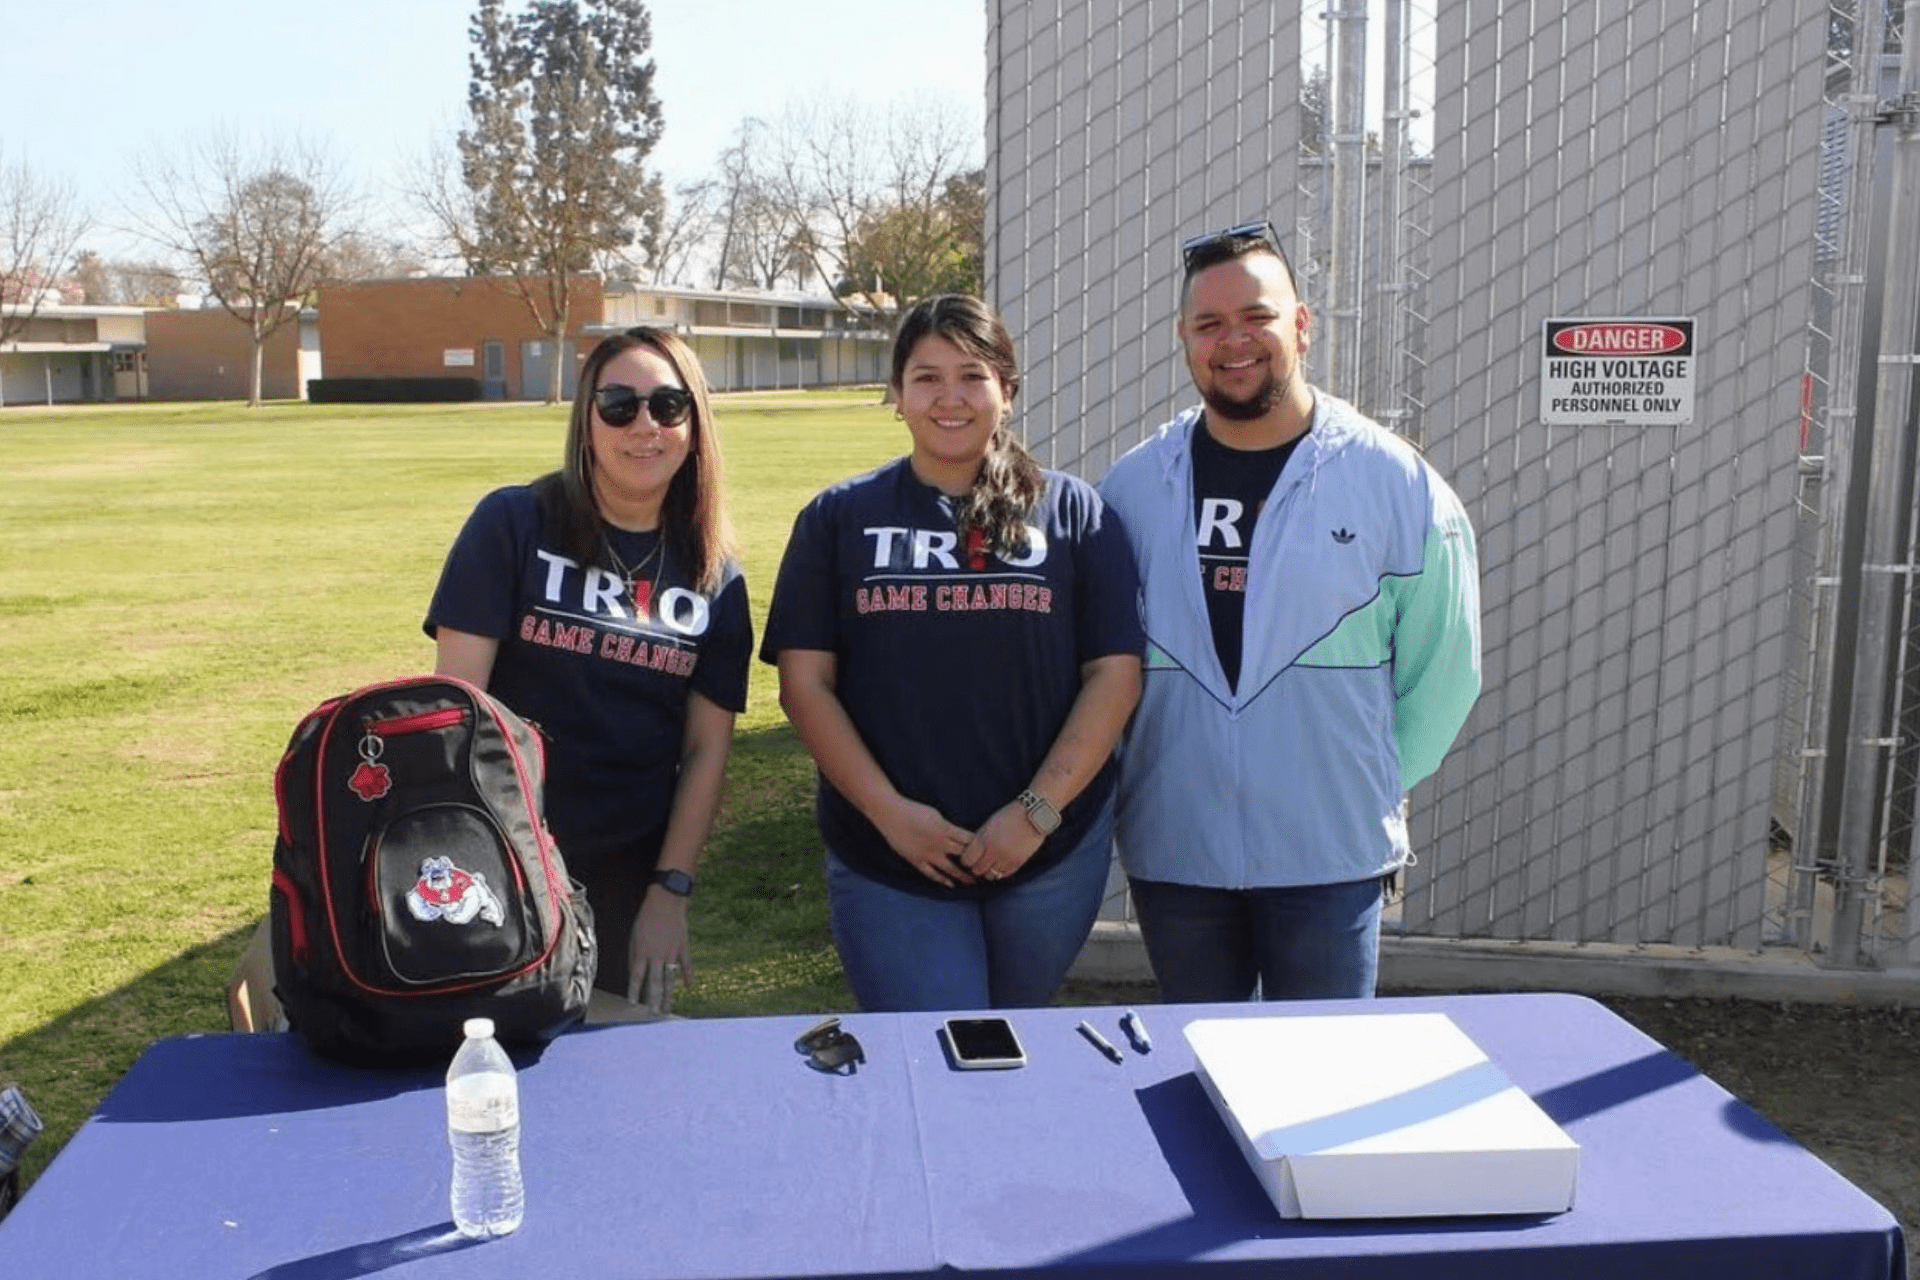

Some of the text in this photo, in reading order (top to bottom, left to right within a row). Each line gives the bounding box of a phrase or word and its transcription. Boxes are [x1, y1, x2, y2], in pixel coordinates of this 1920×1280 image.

[1573, 329, 1665, 350] DANGER
[1550, 360, 1687, 379] HIGH VOLTAGE
[1571, 381, 1664, 396] AUTHORIZED
[1552, 398, 1681, 413] PERSONNEL ONLY
[856, 583, 1052, 614] GAME CHANGER
[520, 614, 697, 677] GAME CHANGE
